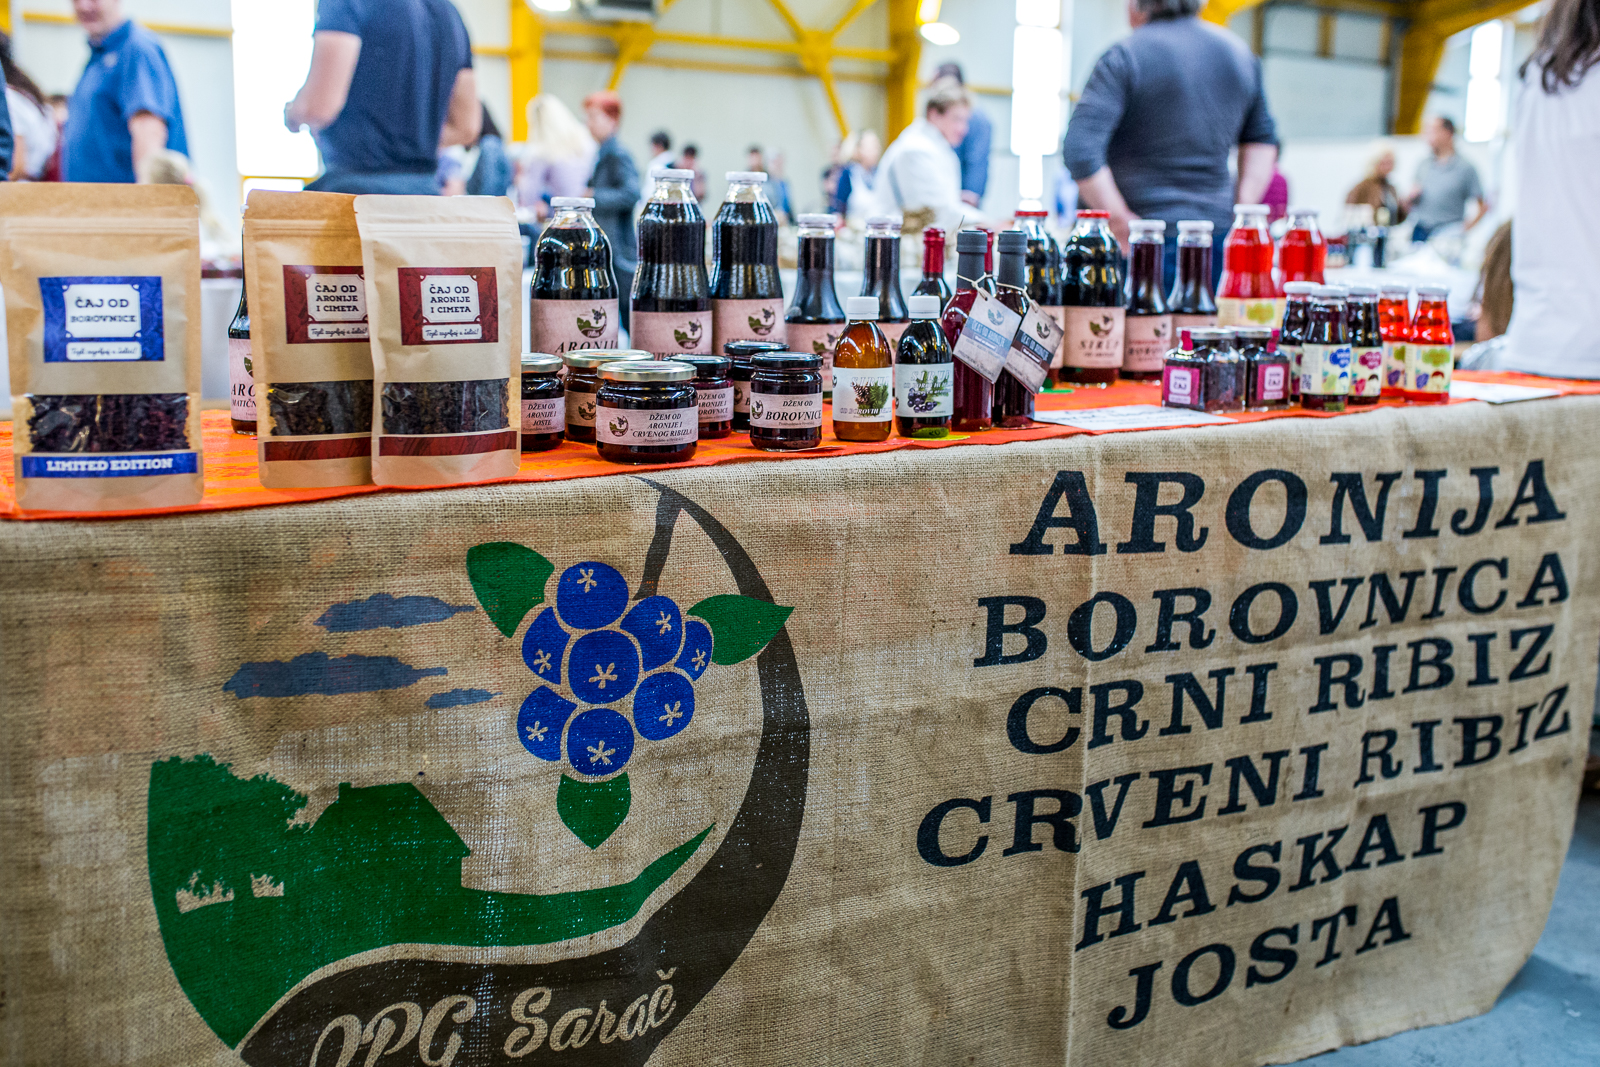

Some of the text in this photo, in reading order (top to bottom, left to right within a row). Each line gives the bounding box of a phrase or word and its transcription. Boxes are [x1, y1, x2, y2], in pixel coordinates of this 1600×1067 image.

[315, 282, 357, 293] ČAJ OD
[429, 283, 470, 294] ČAJ OD
[75, 296, 129, 308] ČAJ OD
[316, 294, 358, 302] ARONIJE
[430, 295, 471, 303] ARONIJE
[70, 315, 136, 323] BOROVNICE
[526, 411, 554, 419] ARONIJE
[649, 413, 671, 421] DŽEM
[765, 410, 822, 421] BOROVNICE
[632, 430, 669, 438] CRVENOG
[46, 458, 173, 472] LIMITED EDITION
[1009, 459, 1566, 556] ARONIJA
[973, 552, 1570, 668] BOROVNICA
[1006, 624, 1555, 755] CRNI RIBIZ
[916, 685, 1571, 867] CRVENI RIBIZ
[1075, 801, 1467, 952] HASKAP
[1106, 897, 1411, 1030] JOSTA
[503, 967, 678, 1058] Sarač
